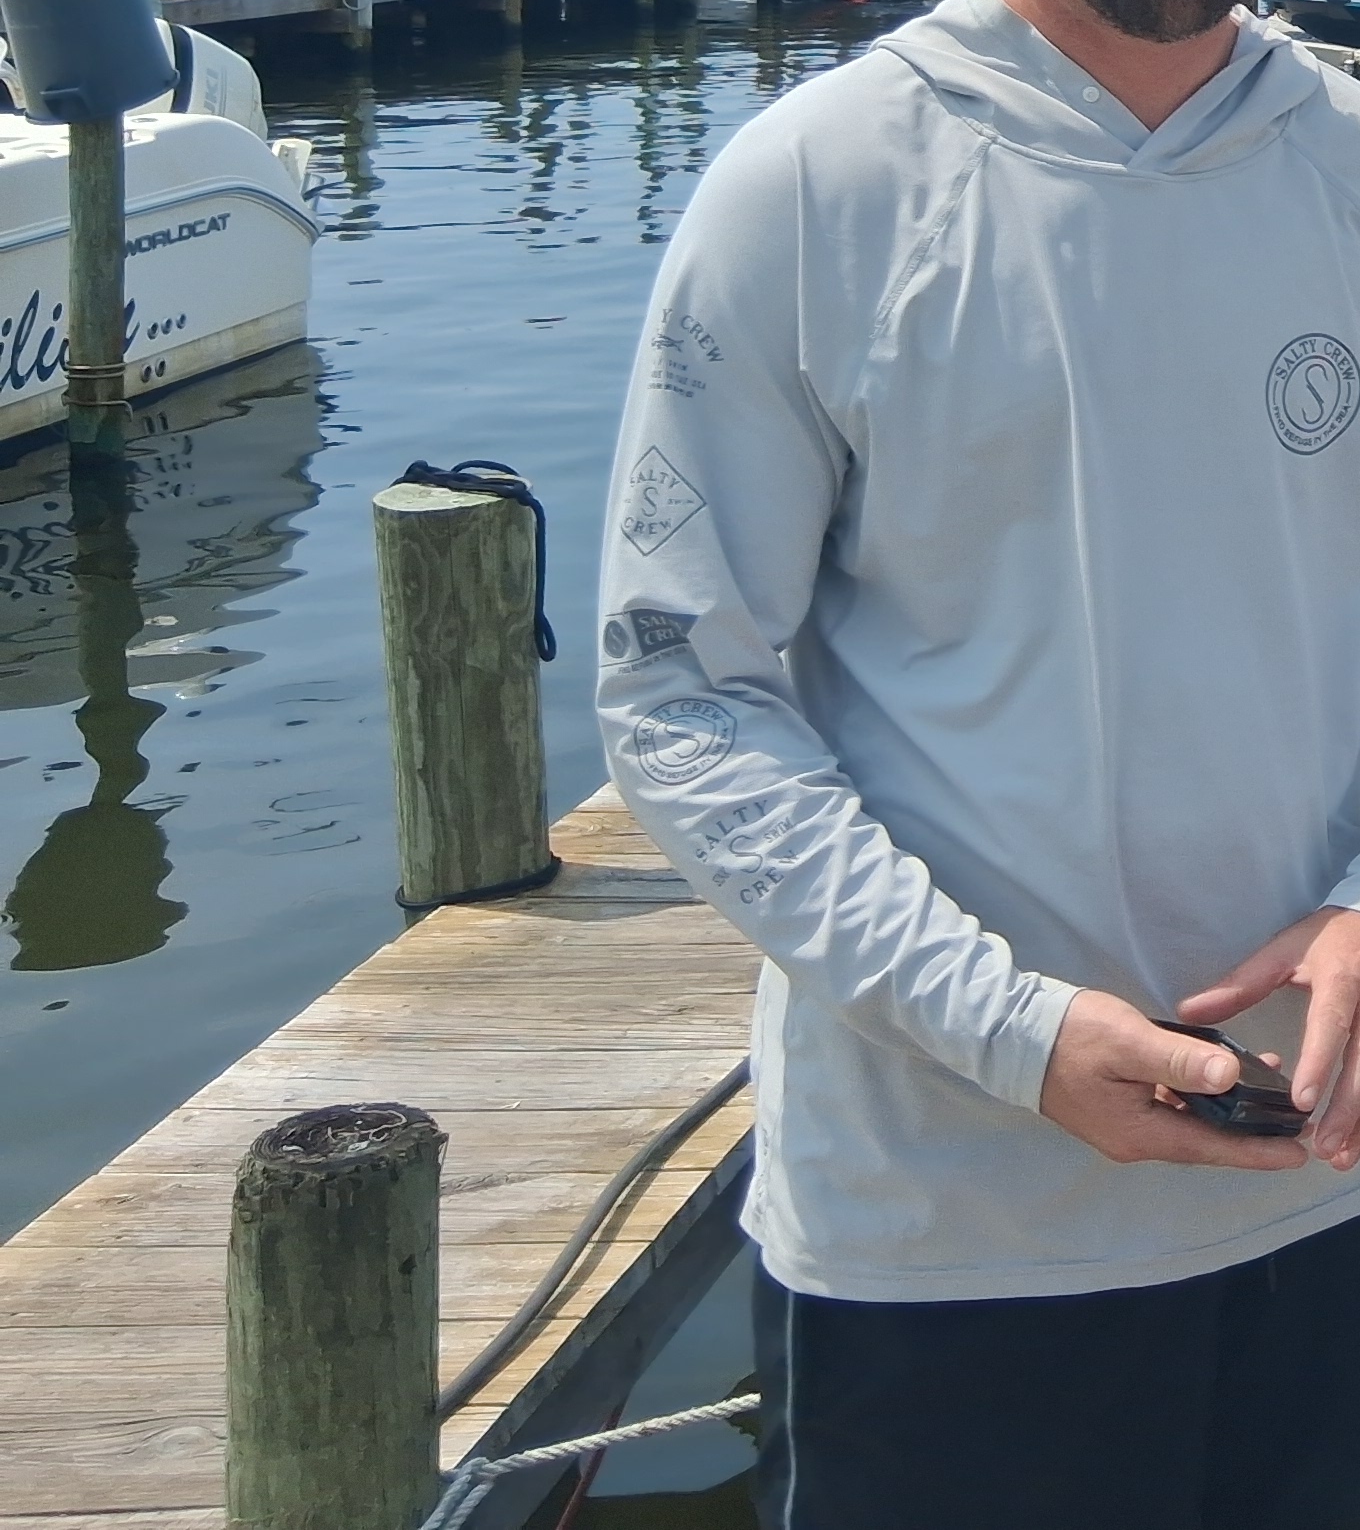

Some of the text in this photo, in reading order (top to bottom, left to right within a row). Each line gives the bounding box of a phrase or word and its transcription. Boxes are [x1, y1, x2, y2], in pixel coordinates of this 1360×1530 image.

[681, 315, 724, 362] CREW
[1275, 339, 1355, 381] SALTY CREW
[624, 516, 672, 534] CREW
[680, 701, 723, 721] CREW
[695, 800, 768, 863] SALTY
